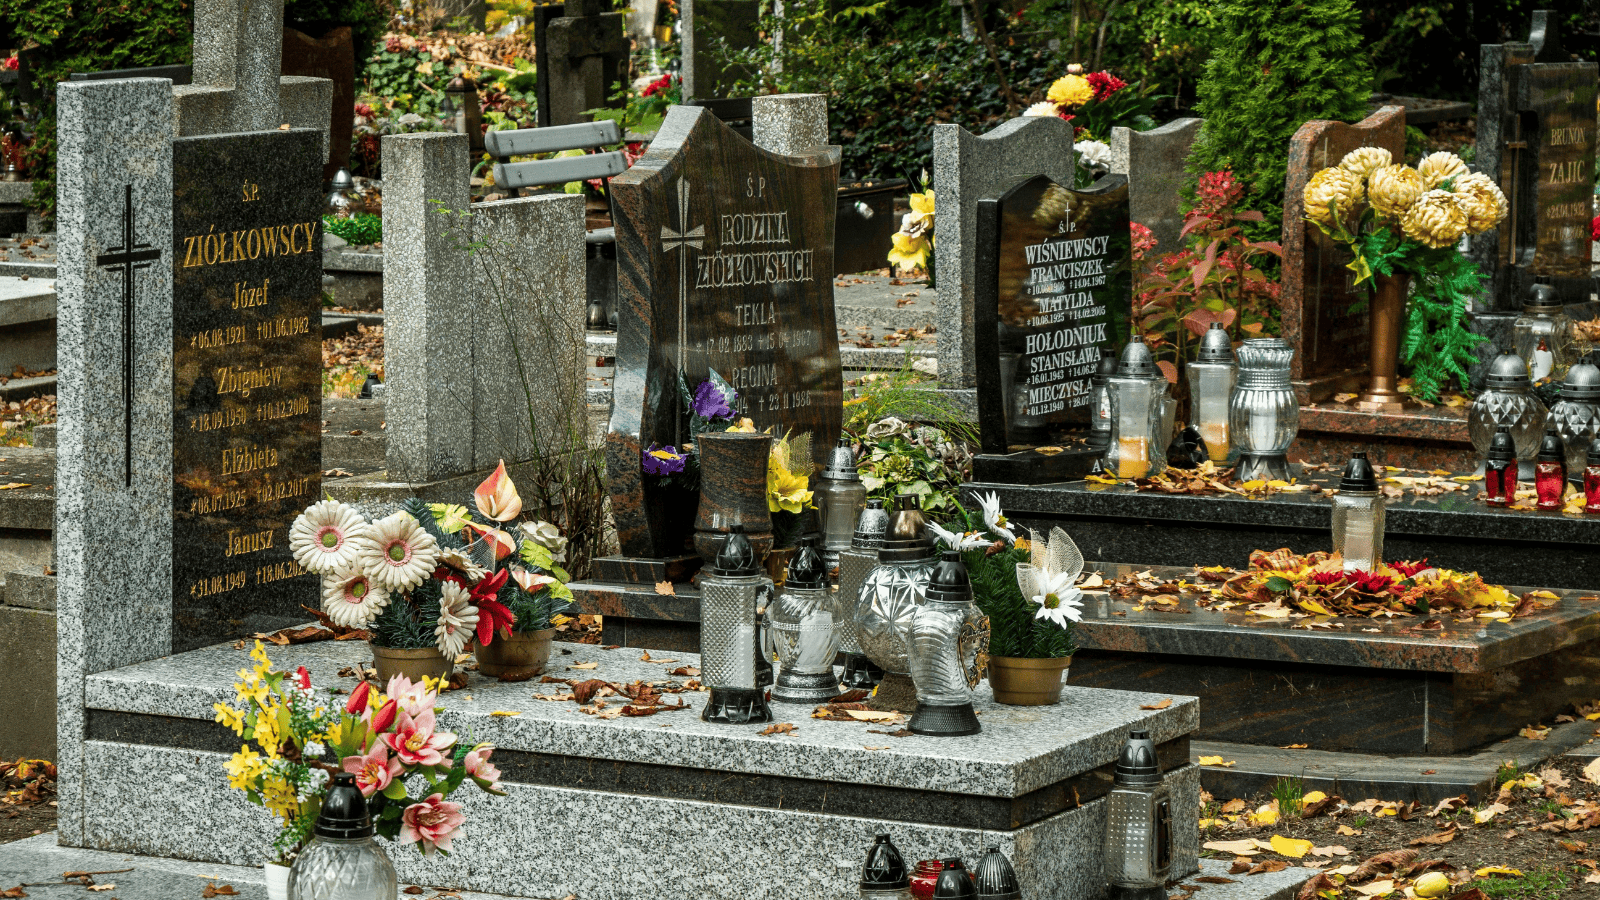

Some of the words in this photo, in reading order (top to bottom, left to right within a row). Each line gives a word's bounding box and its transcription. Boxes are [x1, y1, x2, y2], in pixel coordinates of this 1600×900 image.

[1550, 126, 1586, 146] BRUNON
[721, 211, 791, 245] RODZINA
[183, 221, 317, 268] ZIÓŁKOWSCY
[1025, 235, 1110, 265] WIŚNIEWSCY
[695, 248, 814, 289] ZIÓŁKOWSKICH
[1030, 258, 1104, 284] FRANCISZEK
[231, 278, 270, 310] Józef
[1038, 290, 1095, 314] MATYLDA
[735, 301, 776, 327] TEKLA
[1025, 322, 1107, 355] HOŁODNIUK
[1030, 345, 1101, 373] STANISŁAWA
[217, 361, 283, 398] Zbigniew
[732, 364, 778, 390] REGINA
[1029, 377, 1093, 405] MIECZYSŁA
[1072, 395, 1090, 408] 28.07
[221, 445, 278, 476] Elżbieta
[225, 528, 273, 558] Janusz
